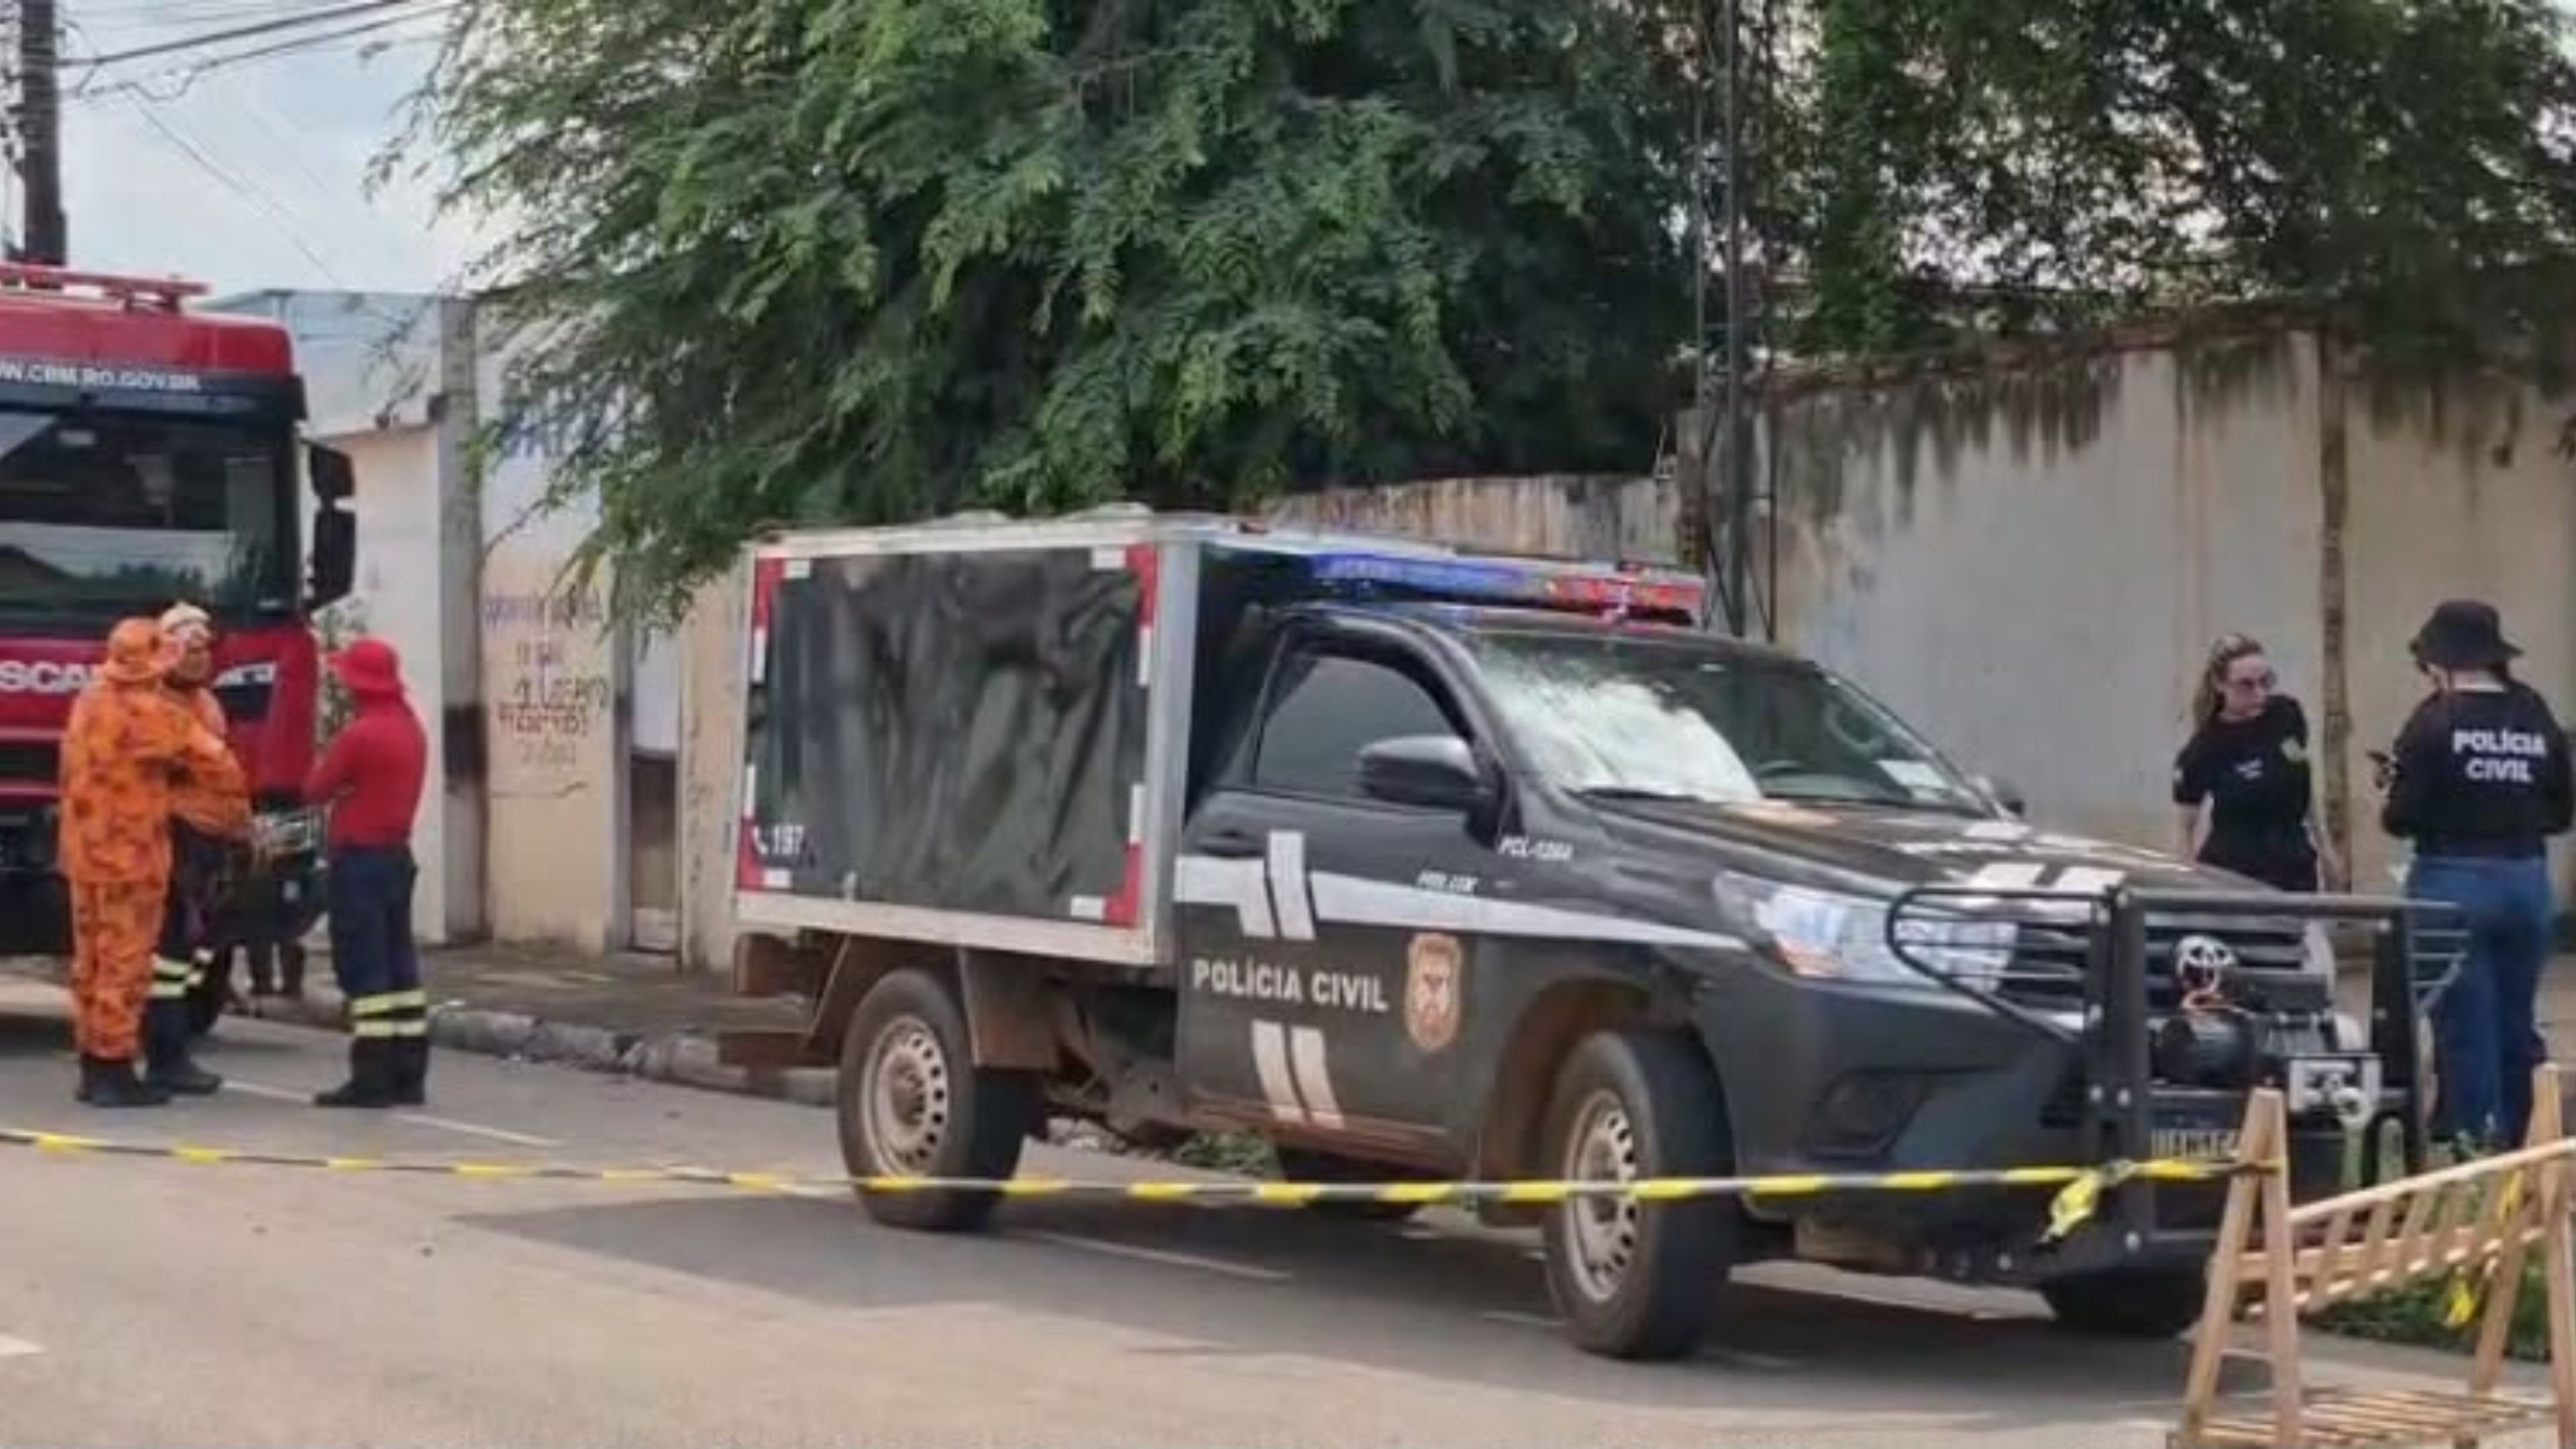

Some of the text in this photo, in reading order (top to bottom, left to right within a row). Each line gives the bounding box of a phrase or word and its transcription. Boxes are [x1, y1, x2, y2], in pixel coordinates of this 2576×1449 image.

[2453, 727, 2546, 756] POLÍCIA
[2466, 758, 2533, 783] CIVIL
[1193, 957, 1390, 1011] POLÍCIA CIVIL
